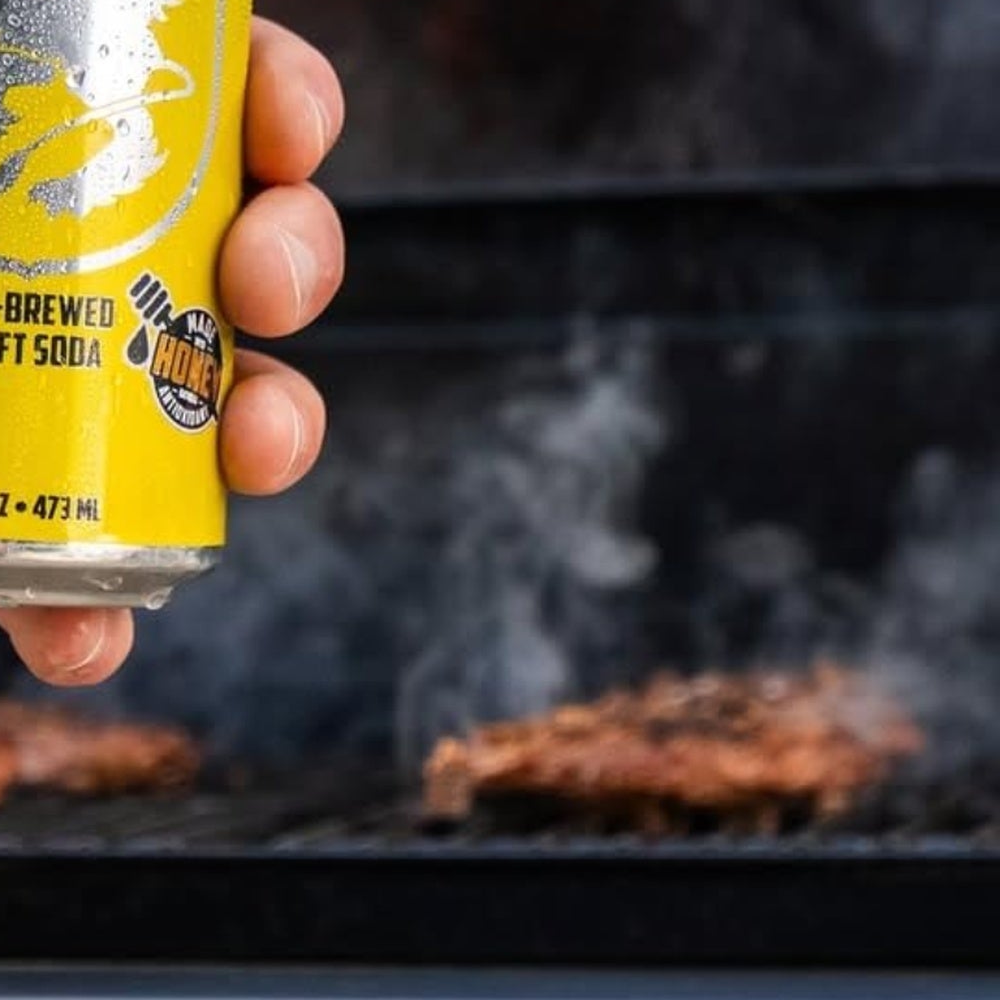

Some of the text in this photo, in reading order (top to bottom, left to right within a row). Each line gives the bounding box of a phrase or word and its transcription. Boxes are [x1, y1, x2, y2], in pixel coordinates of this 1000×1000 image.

[33, 334, 102, 368] SODA
[32, 494, 71, 520] 473
[76, 497, 102, 523] ML
